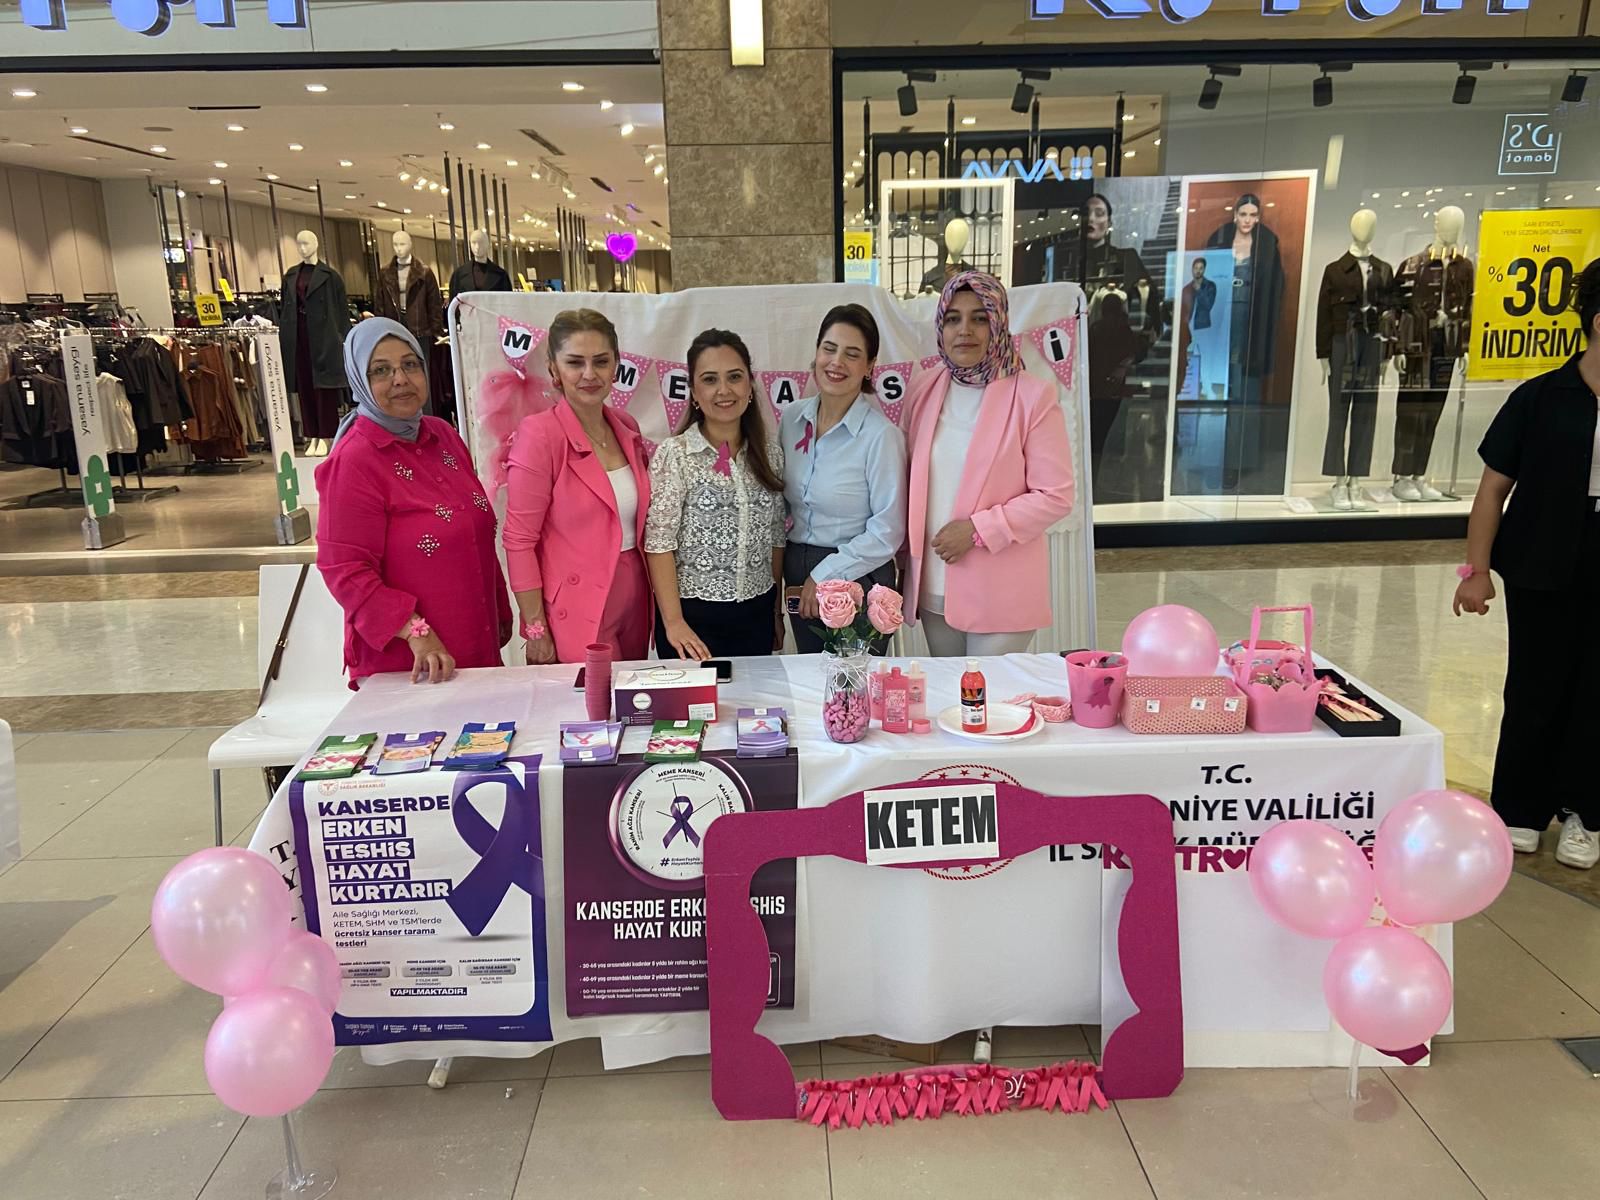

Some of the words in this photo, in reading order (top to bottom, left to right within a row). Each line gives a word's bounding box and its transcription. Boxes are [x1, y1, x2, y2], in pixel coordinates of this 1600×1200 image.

[846, 245, 866, 261] 30
[1533, 244, 1551, 253] Net
[202, 303, 216, 314] 30
[1481, 320, 1582, 359] İNDİRİM
[503, 330, 532, 351] M
[776, 380, 795, 404] A
[882, 375, 903, 400] S
[658, 769, 676, 778] MEME
[678, 768, 706, 778] KANSERİ
[1200, 764, 1252, 785] T.C.
[318, 796, 450, 816] KANSERDE
[628, 789, 642, 814] KANSERİ
[1170, 795, 1238, 822] NİYE
[1245, 791, 1374, 821] VALİLİĞİ
[323, 818, 402, 838] ERKEN
[866, 795, 997, 850] KETEM
[328, 862, 408, 881] HAYAT
[331, 882, 450, 902] KURTARIR
[576, 898, 665, 921] KANSERDE
[614, 922, 664, 940] HAYAT
[391, 988, 466, 996] YAPILMAKTADIR.
